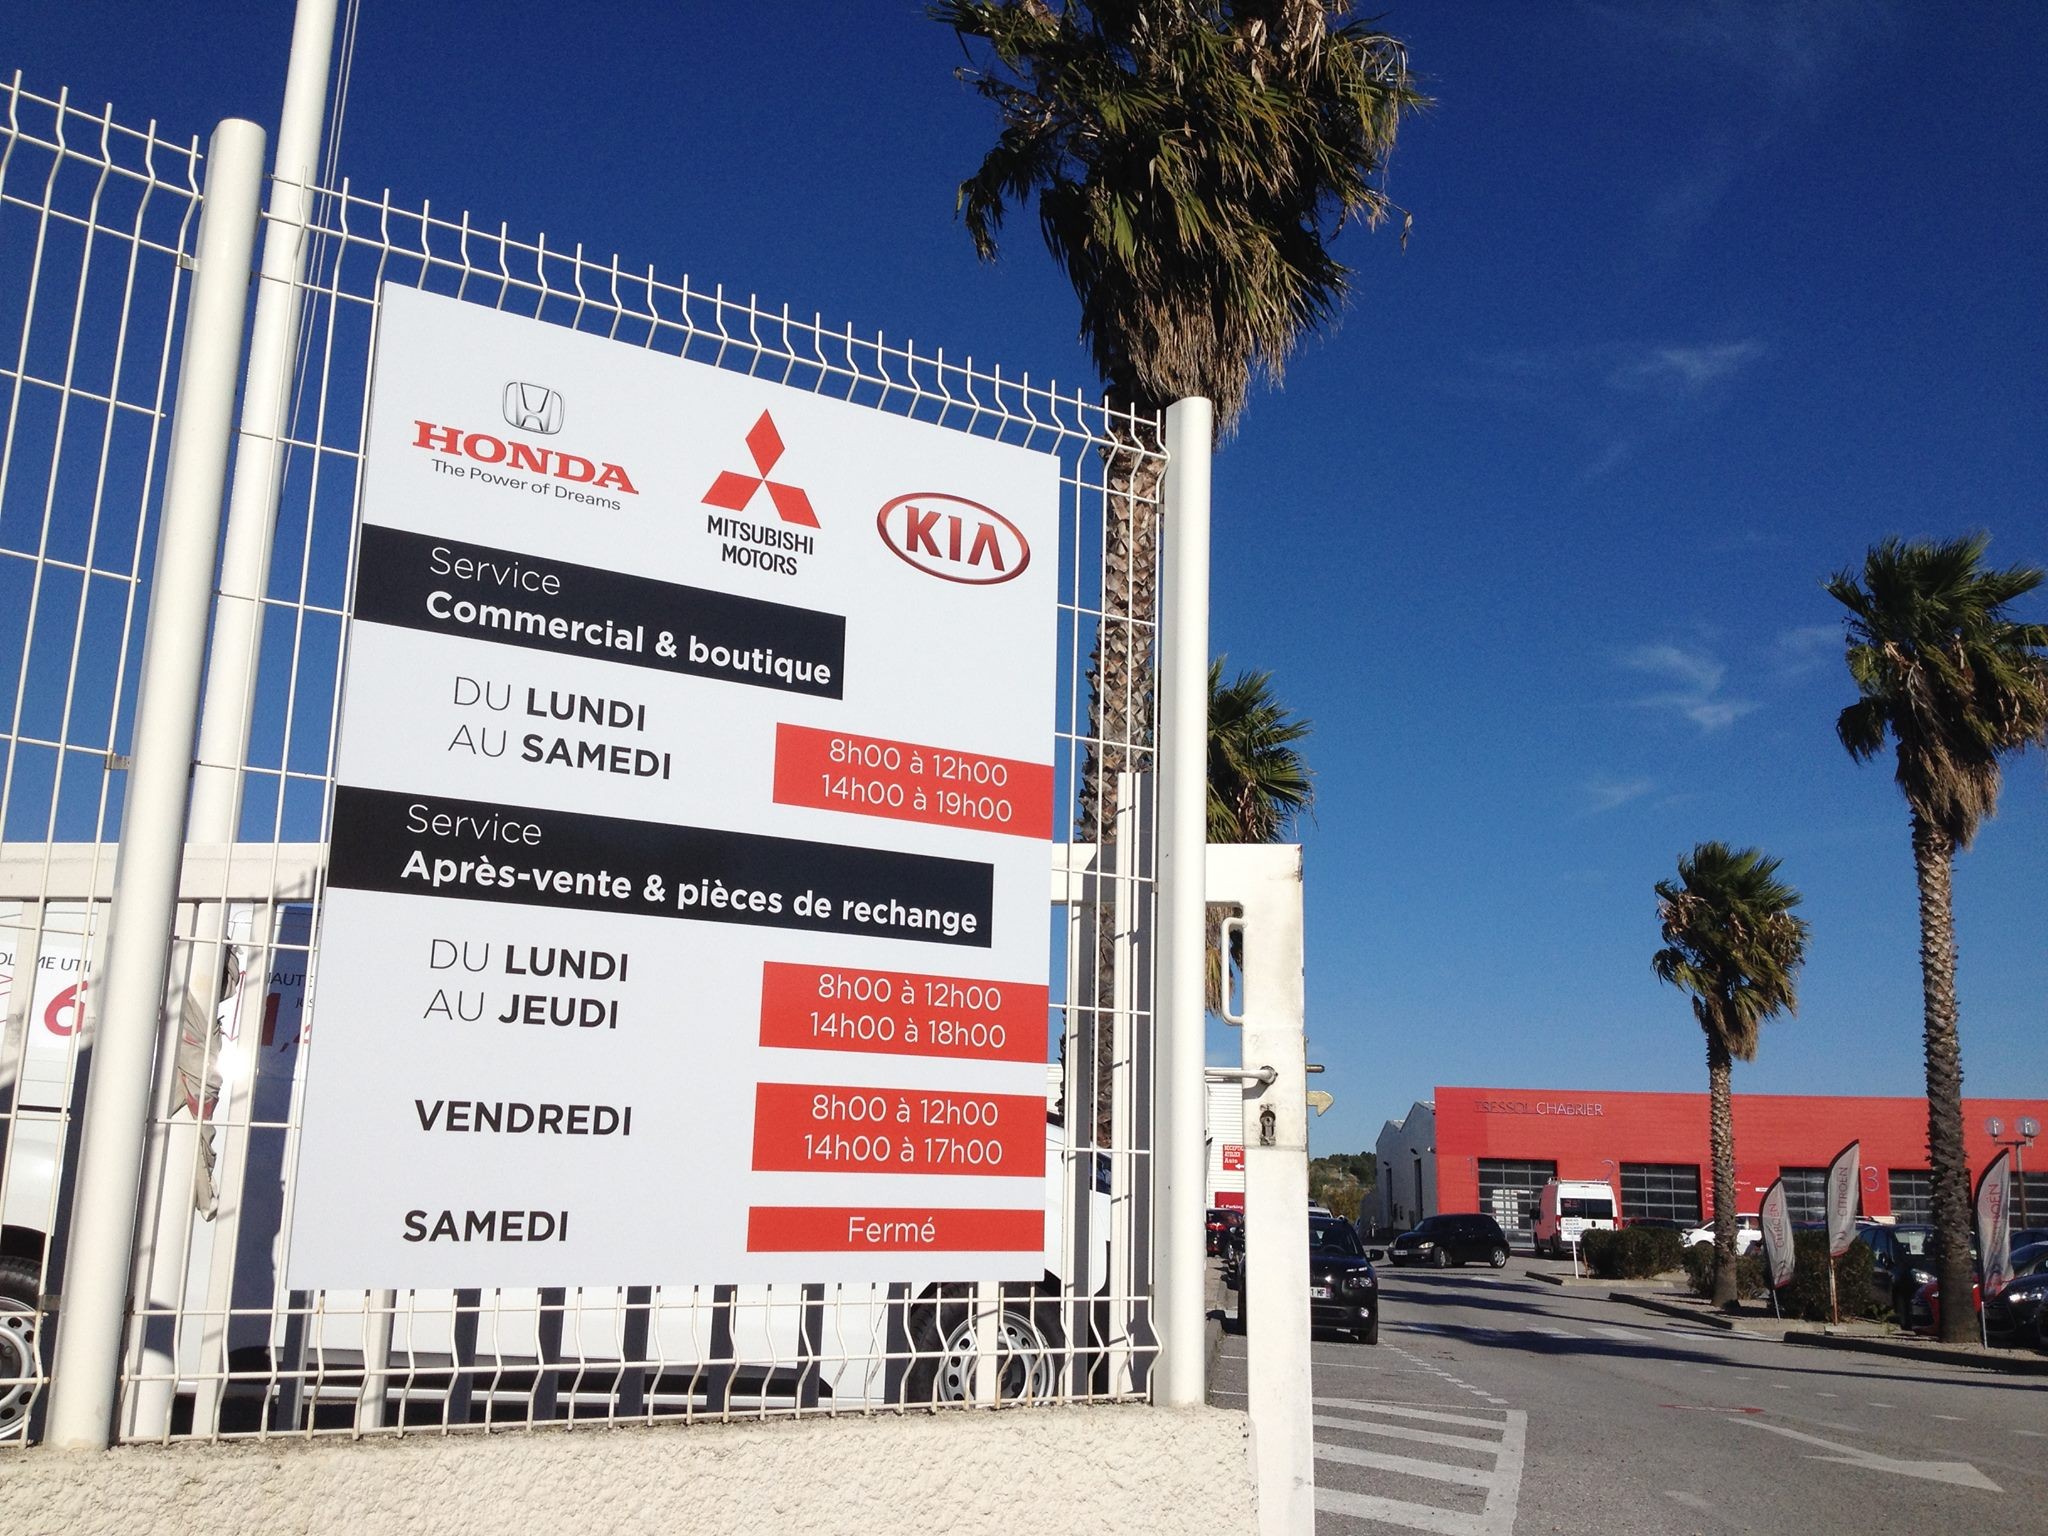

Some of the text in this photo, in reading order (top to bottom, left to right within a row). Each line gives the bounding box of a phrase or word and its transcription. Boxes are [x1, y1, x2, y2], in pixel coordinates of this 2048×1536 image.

[412, 420, 639, 495] HONDA
[432, 459, 620, 510] The Power of Dreams
[707, 515, 813, 555] MITSUBISHI
[905, 505, 1005, 572] KIA
[430, 547, 560, 595] Service
[722, 543, 797, 575] MOTORS
[426, 592, 830, 684] Commercial & boutique
[454, 677, 645, 731] DU LUNDI
[448, 725, 670, 779] AU SAMEDI
[830, 739, 1007, 786] 8h00 à 12h00
[822, 774, 1012, 822] 14h00 à 19h00
[407, 804, 541, 845] Service
[401, 850, 977, 936] Après-vente & pièces de rechange
[430, 939, 628, 982] DU LUNDI
[424, 989, 618, 1029] AU JEUDI
[819, 974, 1001, 1011] 8h00 à 12h00
[811, 1012, 1005, 1048] 14h00 à 18h00
[415, 1100, 631, 1136] VENDREDI
[813, 1094, 998, 1126] 8h00 à 12h00
[1536, 1102, 1604, 1116] CHABRIER
[805, 1134, 1002, 1164] 14h00 à 17h00
[1864, 1166, 1880, 1192] 3
[403, 1210, 568, 1242] SAMEDI
[849, 1217, 935, 1242] Fermé
